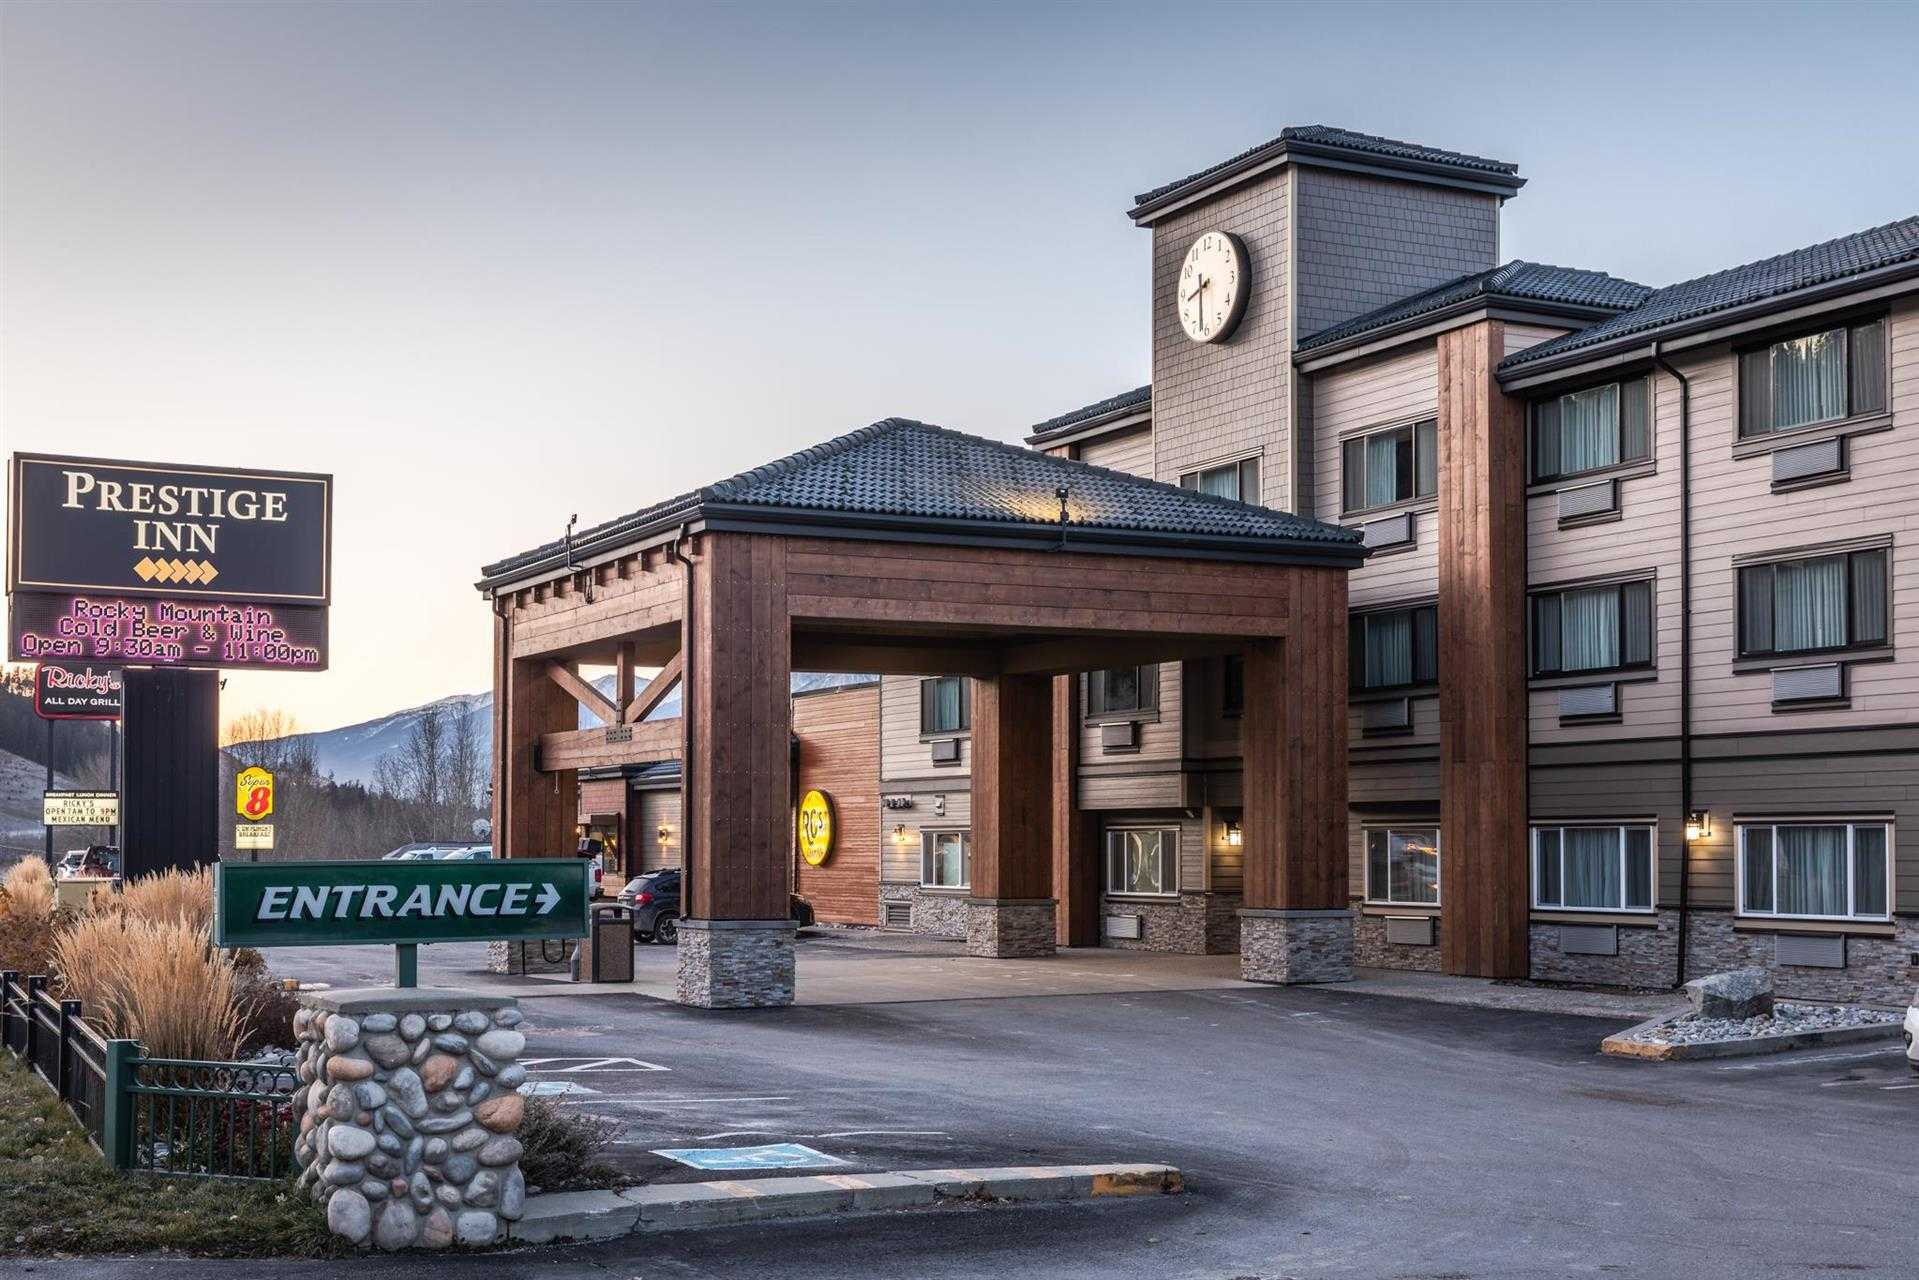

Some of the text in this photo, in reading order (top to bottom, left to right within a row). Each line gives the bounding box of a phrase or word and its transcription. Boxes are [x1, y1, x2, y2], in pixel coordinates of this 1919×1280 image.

[62, 470, 289, 522] PRESTIGE
[133, 520, 220, 554] INN
[73, 599, 271, 625] Rocky Mountain
[60, 617, 284, 642] Cold Beer & Wine
[23, 634, 81, 655] Open
[95, 636, 182, 657] 9:30am
[225, 641, 319, 664] 11:00pm
[44, 697, 121, 706] ALL DAY GRILL
[240, 774, 270, 792] Super
[63, 800, 95, 808] RICKY'S
[246, 786, 271, 816] 8
[257, 882, 533, 920] ENTRANCE
